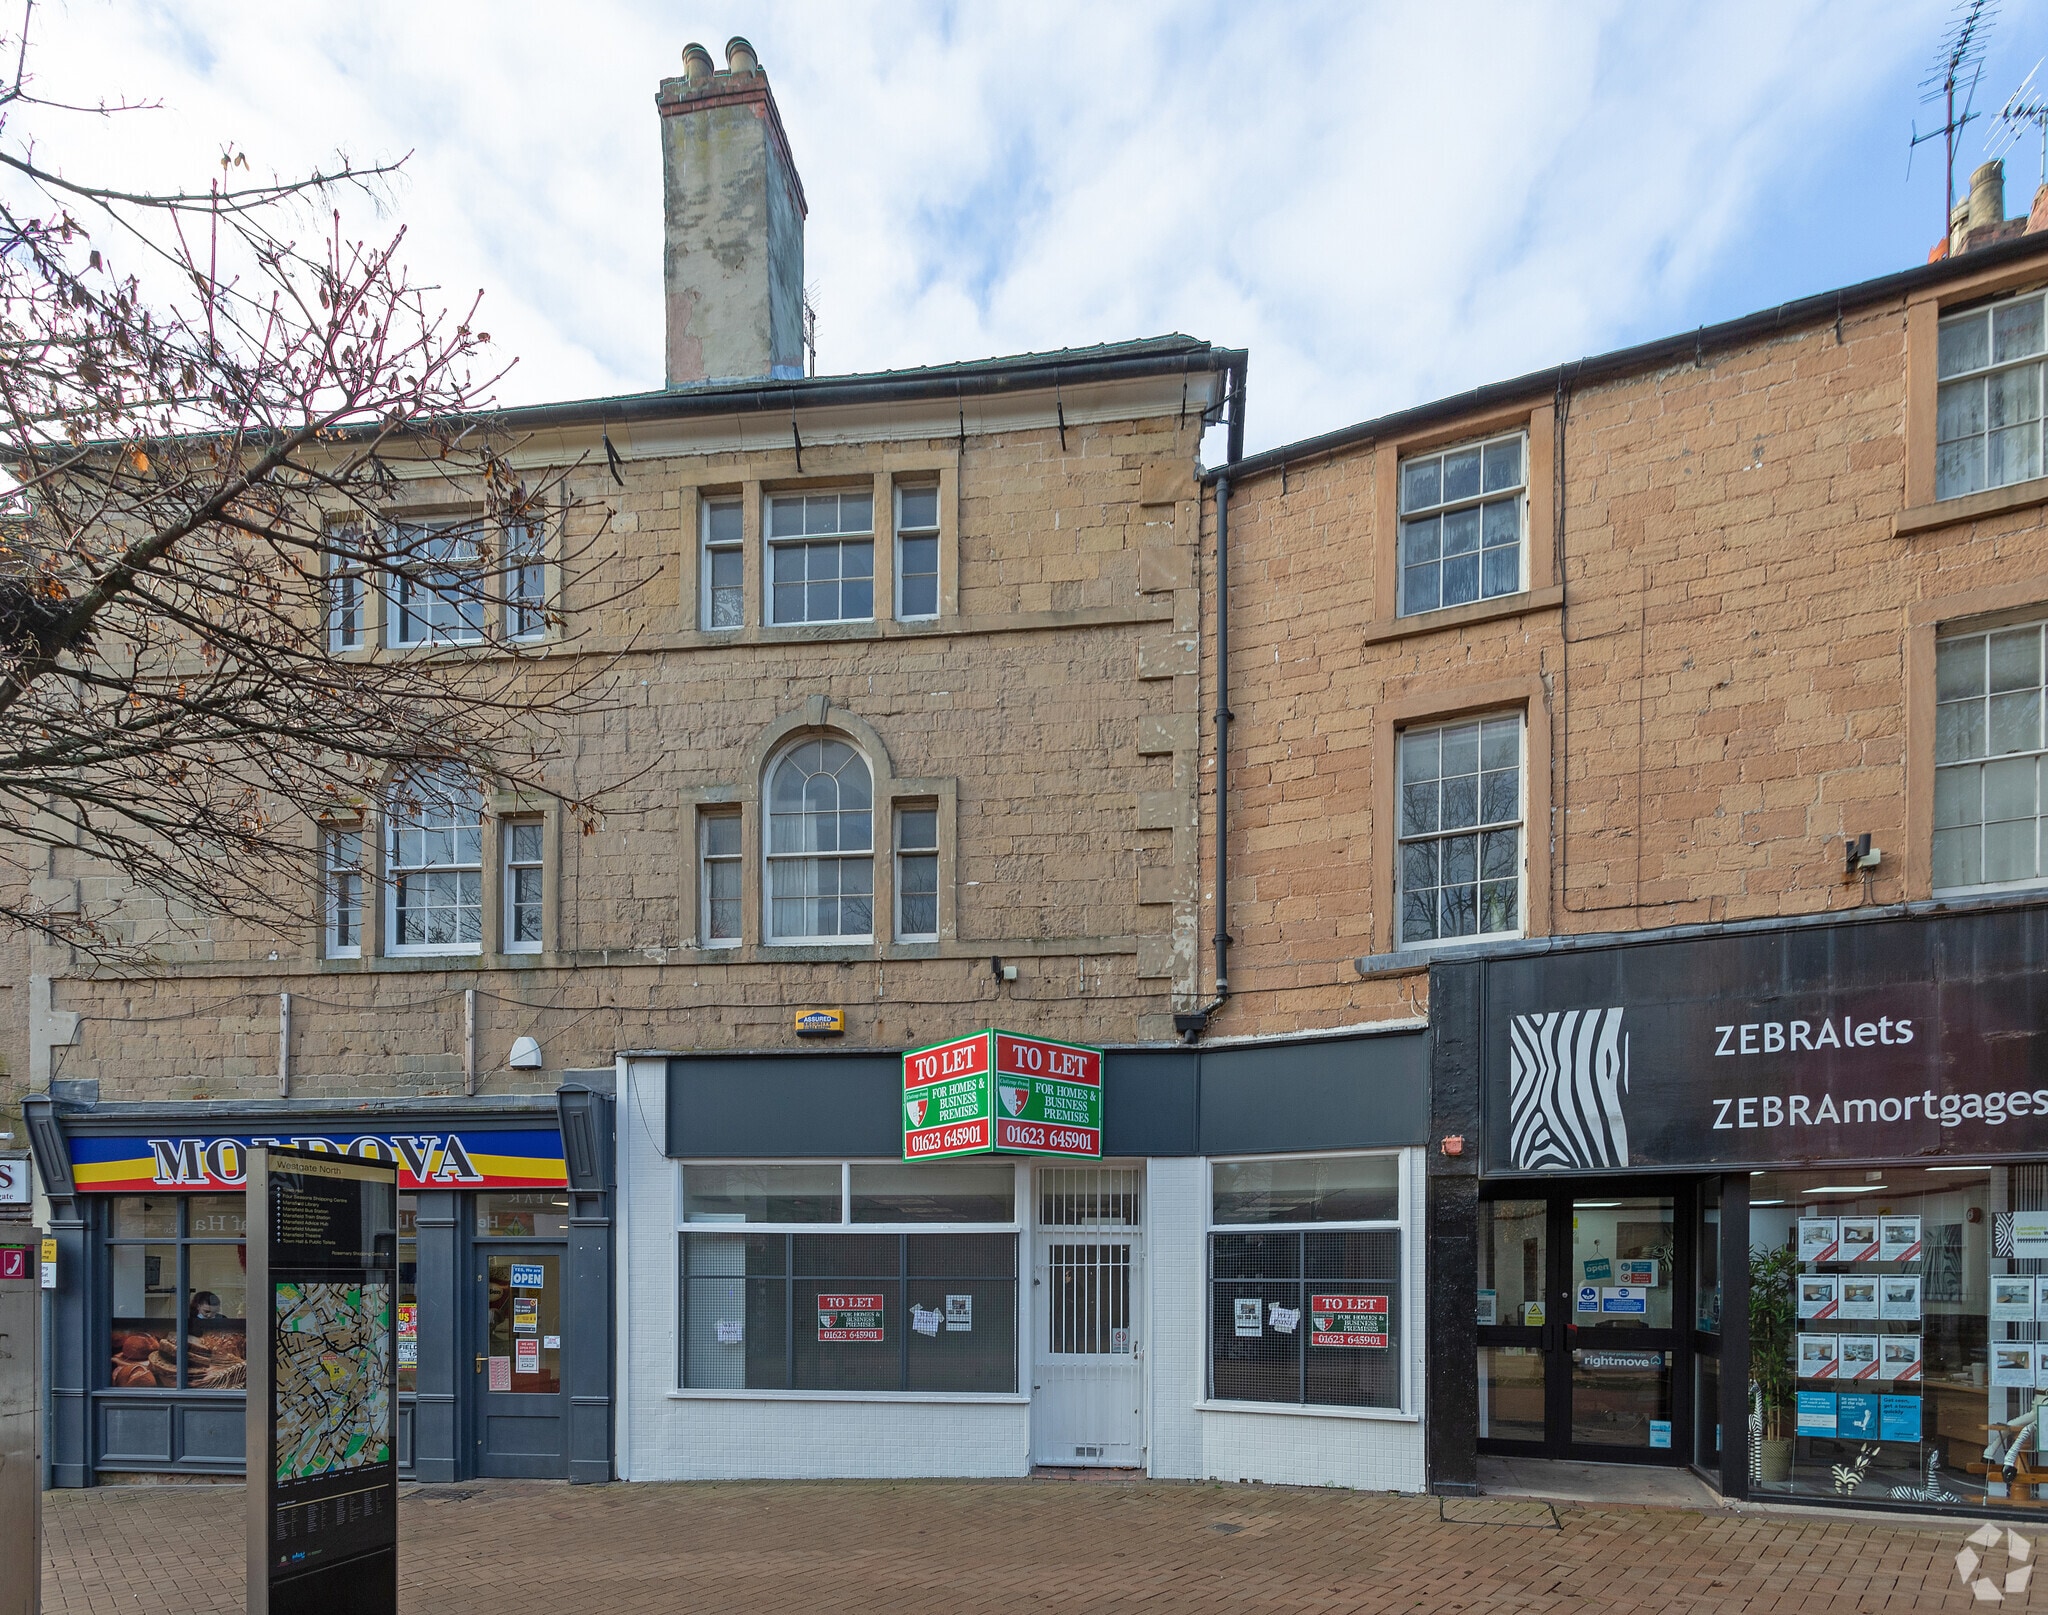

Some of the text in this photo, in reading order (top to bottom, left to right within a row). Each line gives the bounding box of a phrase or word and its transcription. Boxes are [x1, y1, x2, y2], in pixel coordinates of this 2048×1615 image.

[1714, 1016, 1914, 1056] ZEBRAlets
[915, 1045, 975, 1080] TO LET
[1012, 1045, 1087, 1078] TO LET
[933, 1085, 946, 1099] FOR
[949, 1079, 976, 1094] HOMES
[978, 1078, 985, 1089] &
[1036, 1082, 1054, 1096] FOR
[1057, 1085, 1088, 1100] HOMES
[1090, 1091, 1096, 1102] &
[940, 1092, 976, 1109] BUSINESS
[1045, 1098, 1088, 1112] BUSINESS
[939, 1105, 978, 1121] PREMISES
[1044, 1108, 1090, 1123] PREMISES
[1712, 1090, 2048, 1129] ZEBRAmortgages
[912, 1125, 981, 1152] 01623 645901
[1006, 1125, 1092, 1150] 01623 645901
[277, 1161, 341, 1174] Westgate North
[1586, 1264, 1609, 1273] open
[513, 1273, 541, 1284] OPEN
[827, 1298, 874, 1307] TO LET
[1322, 1299, 1377, 1310] TO LET
[1318, 1335, 1380, 1344] 01623 645901
[1584, 1356, 1649, 1368] rightmove
